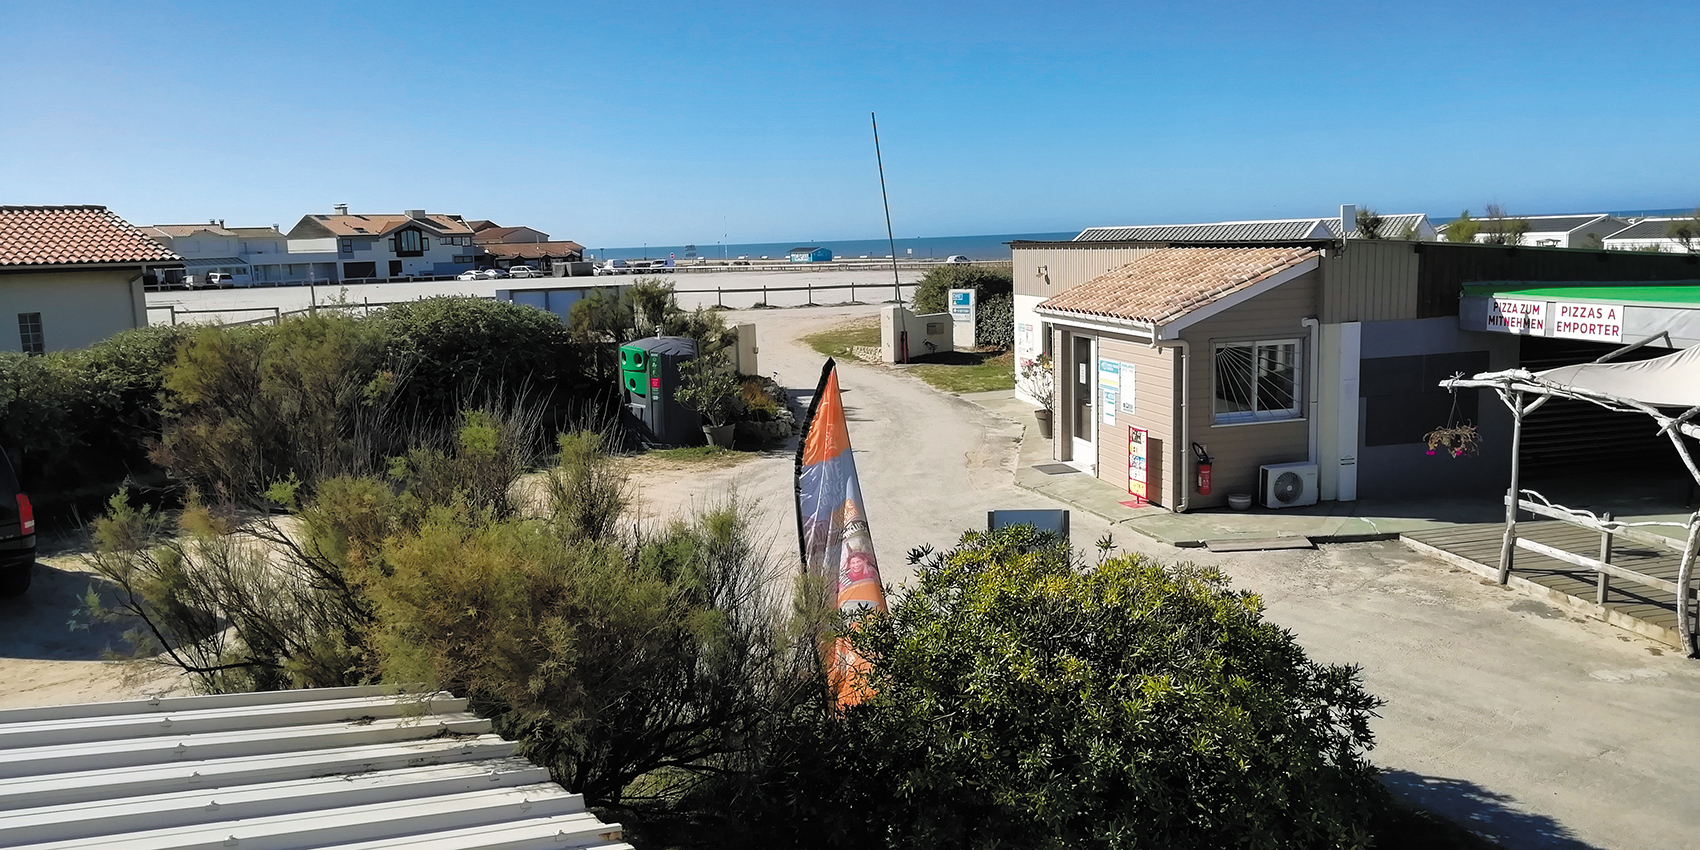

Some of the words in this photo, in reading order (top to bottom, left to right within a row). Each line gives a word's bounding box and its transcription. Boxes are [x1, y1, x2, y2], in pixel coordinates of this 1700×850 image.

[1493, 302, 1518, 314] PIZZA
[1520, 303, 1540, 315] ZUM
[1561, 306, 1603, 319] PIZZAS
[1608, 308, 1616, 320] A
[1488, 315, 1544, 330] MITNEHMEN
[1556, 321, 1620, 336] EMPORTER
